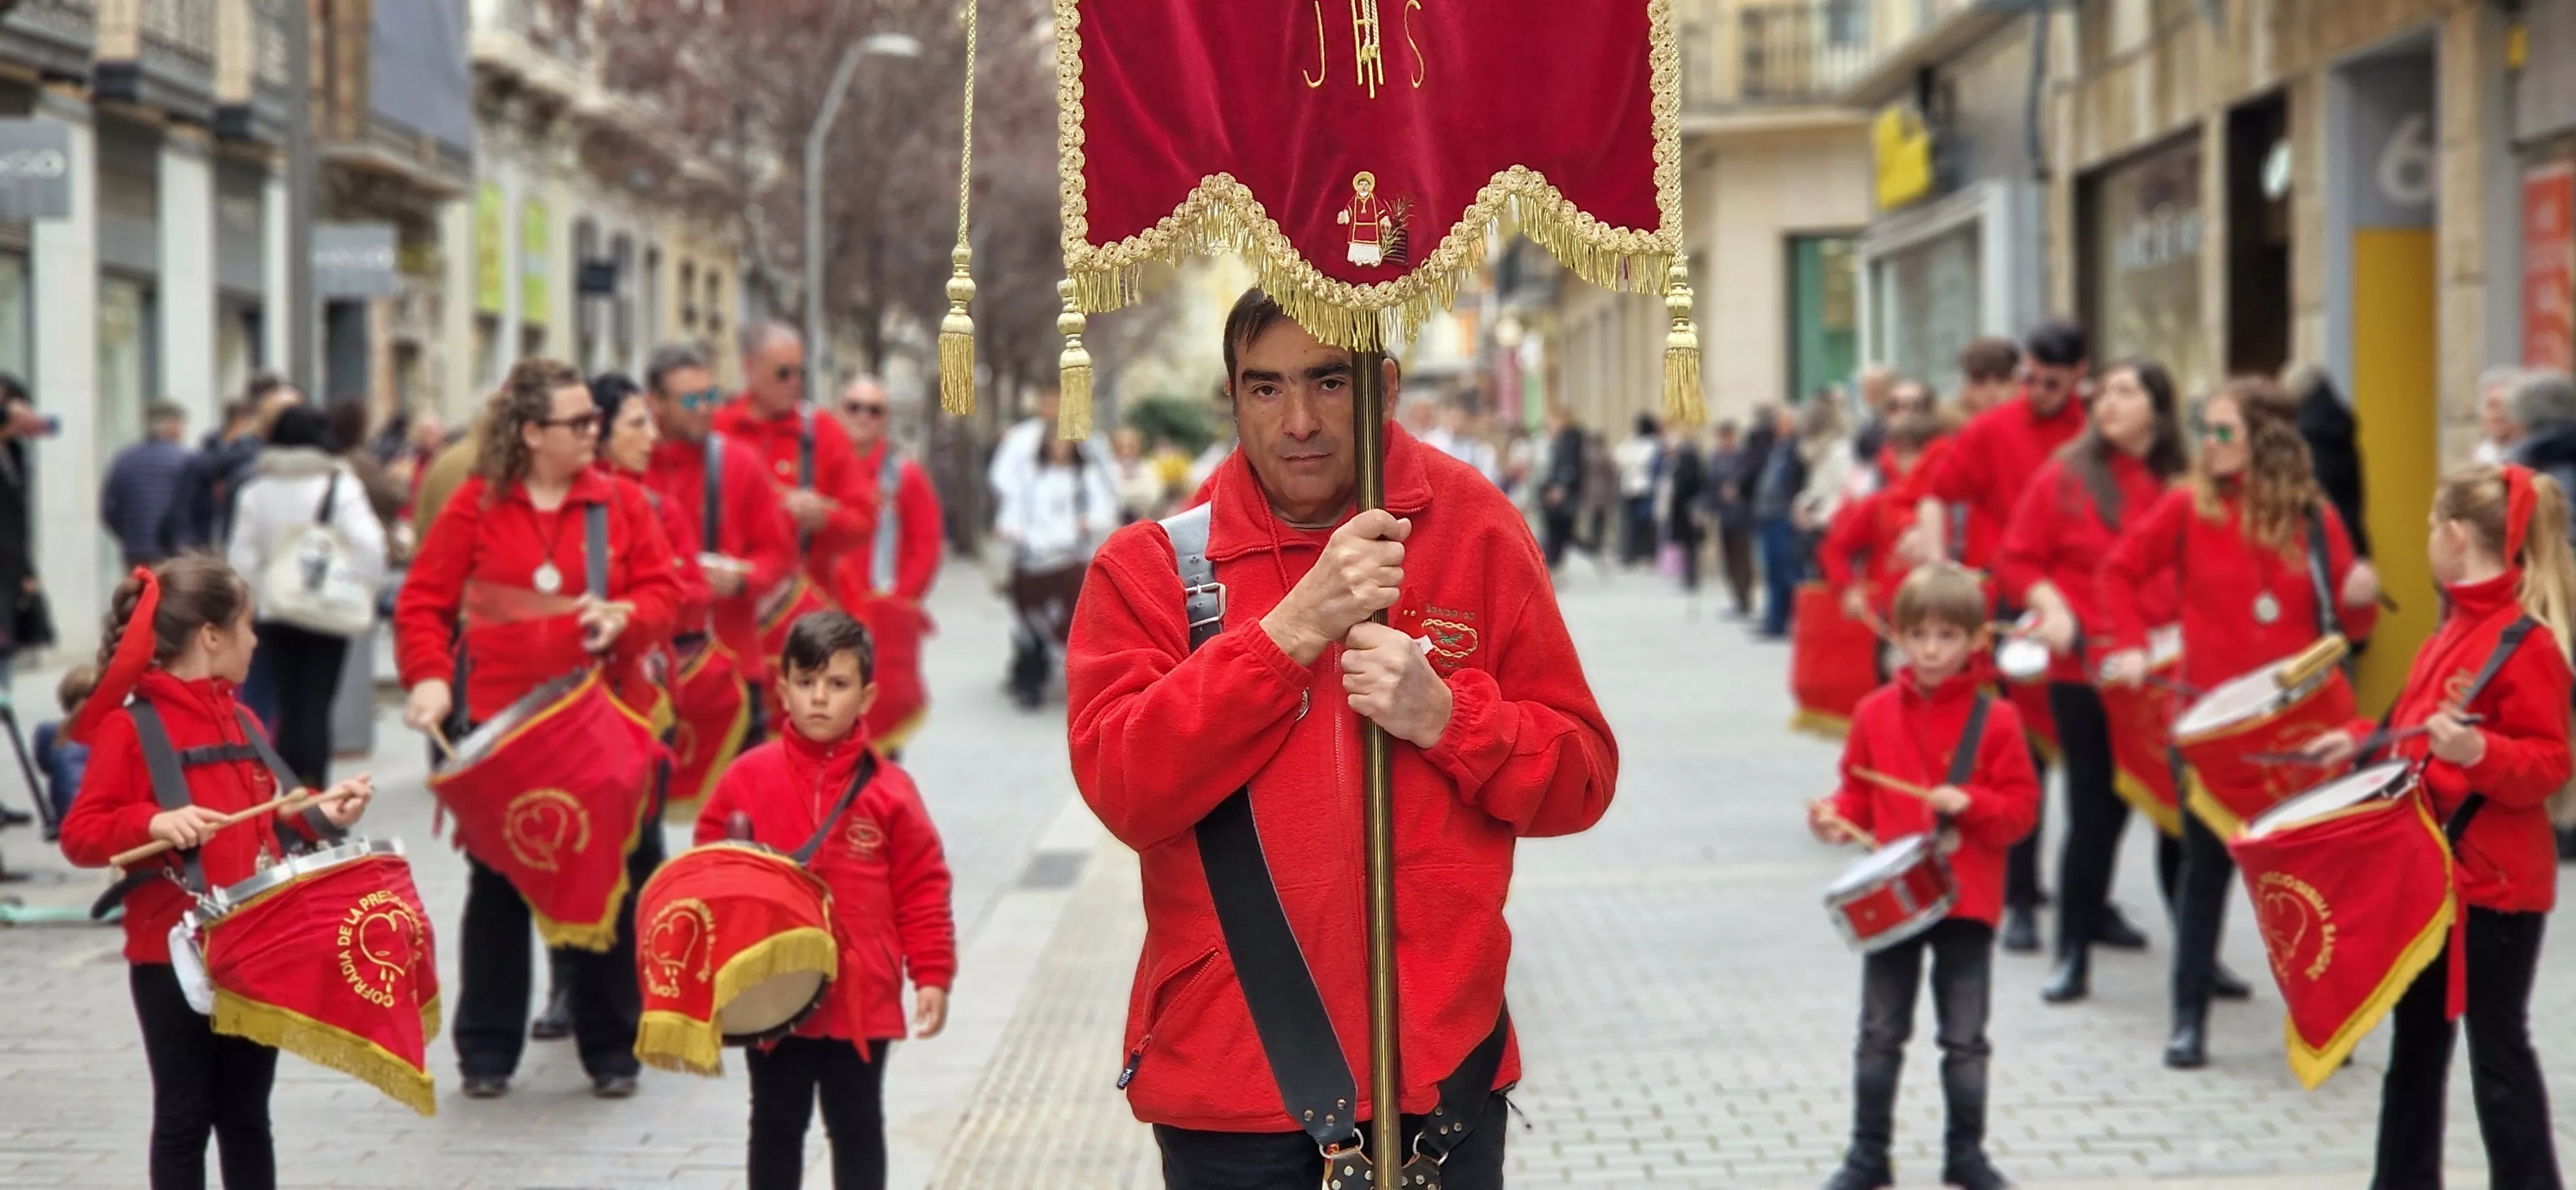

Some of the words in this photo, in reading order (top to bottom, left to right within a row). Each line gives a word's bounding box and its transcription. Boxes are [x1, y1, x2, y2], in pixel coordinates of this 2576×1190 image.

[2376, 111, 2437, 210] 6
[337, 925, 353, 947] DE
[343, 907, 365, 925] LA
[337, 949, 395, 1008] COFRADIA
